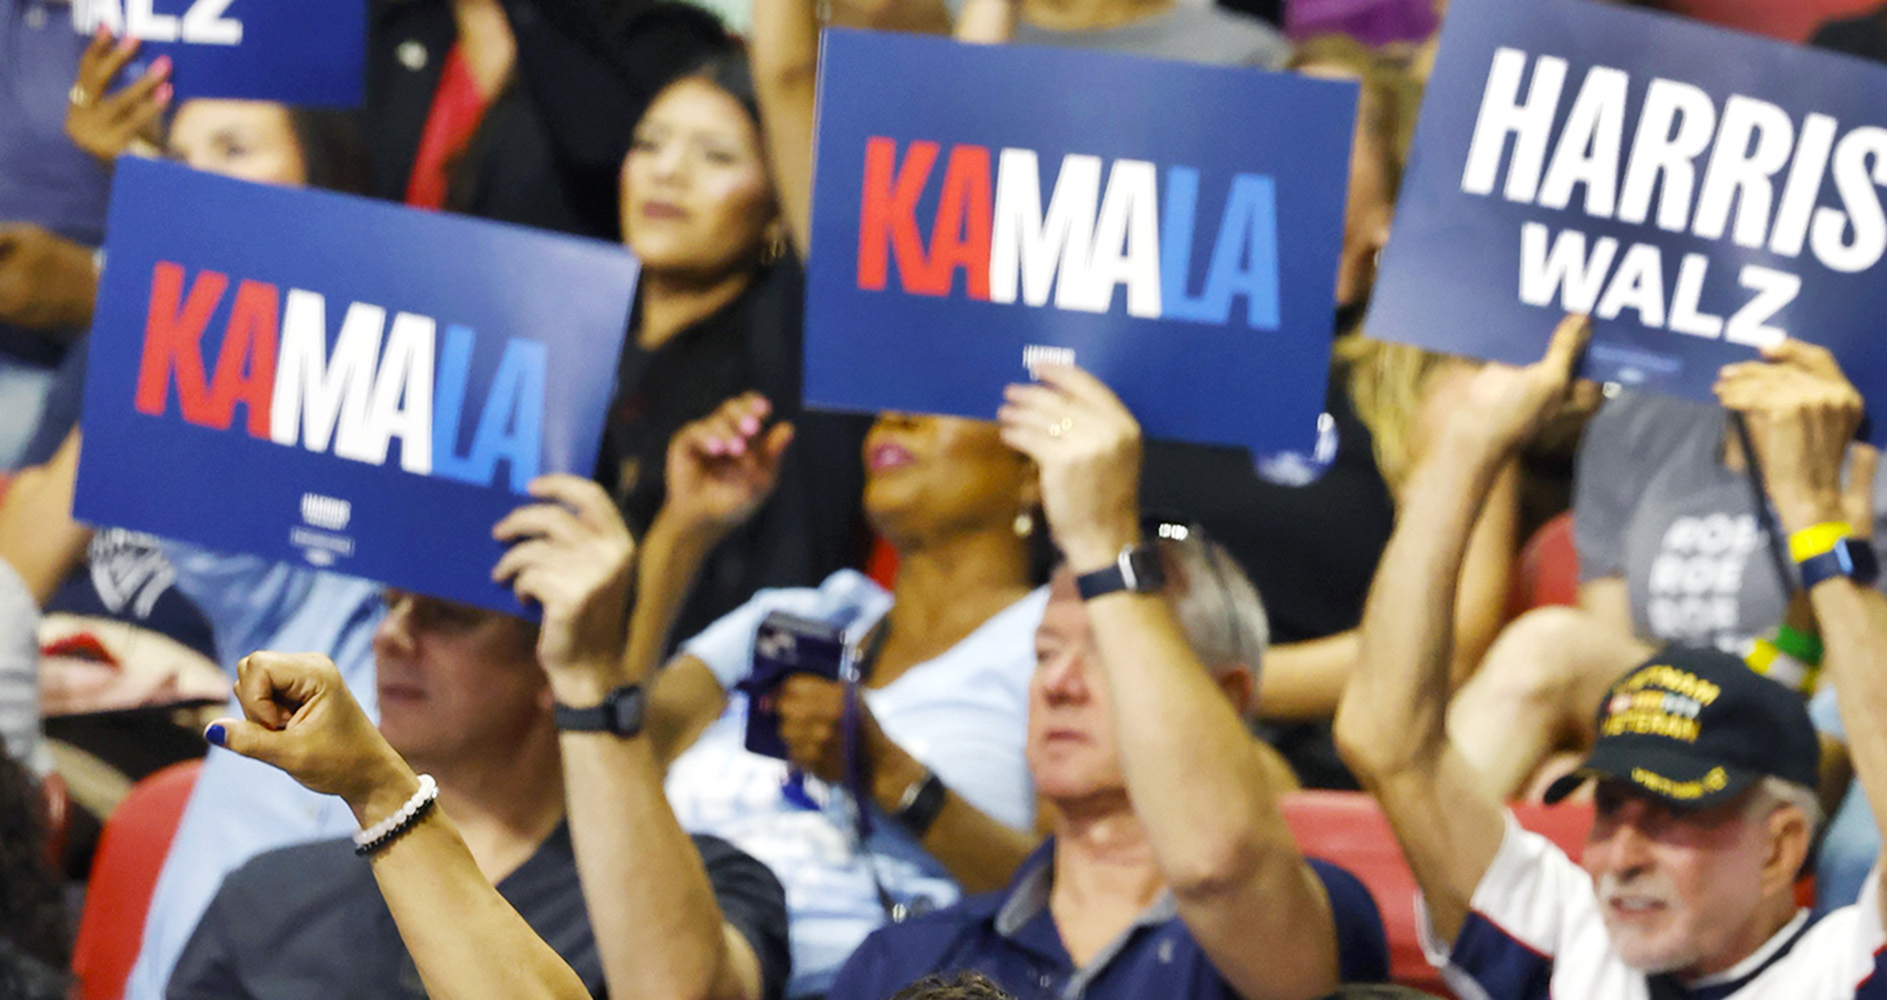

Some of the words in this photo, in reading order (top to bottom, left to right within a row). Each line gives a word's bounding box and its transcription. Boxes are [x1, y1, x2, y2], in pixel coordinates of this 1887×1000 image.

[856, 135, 1280, 331] KAMALA
[1460, 46, 1887, 273] HARRIS
[134, 261, 548, 495] KAMALA
[1518, 221, 1802, 348] WALZ
